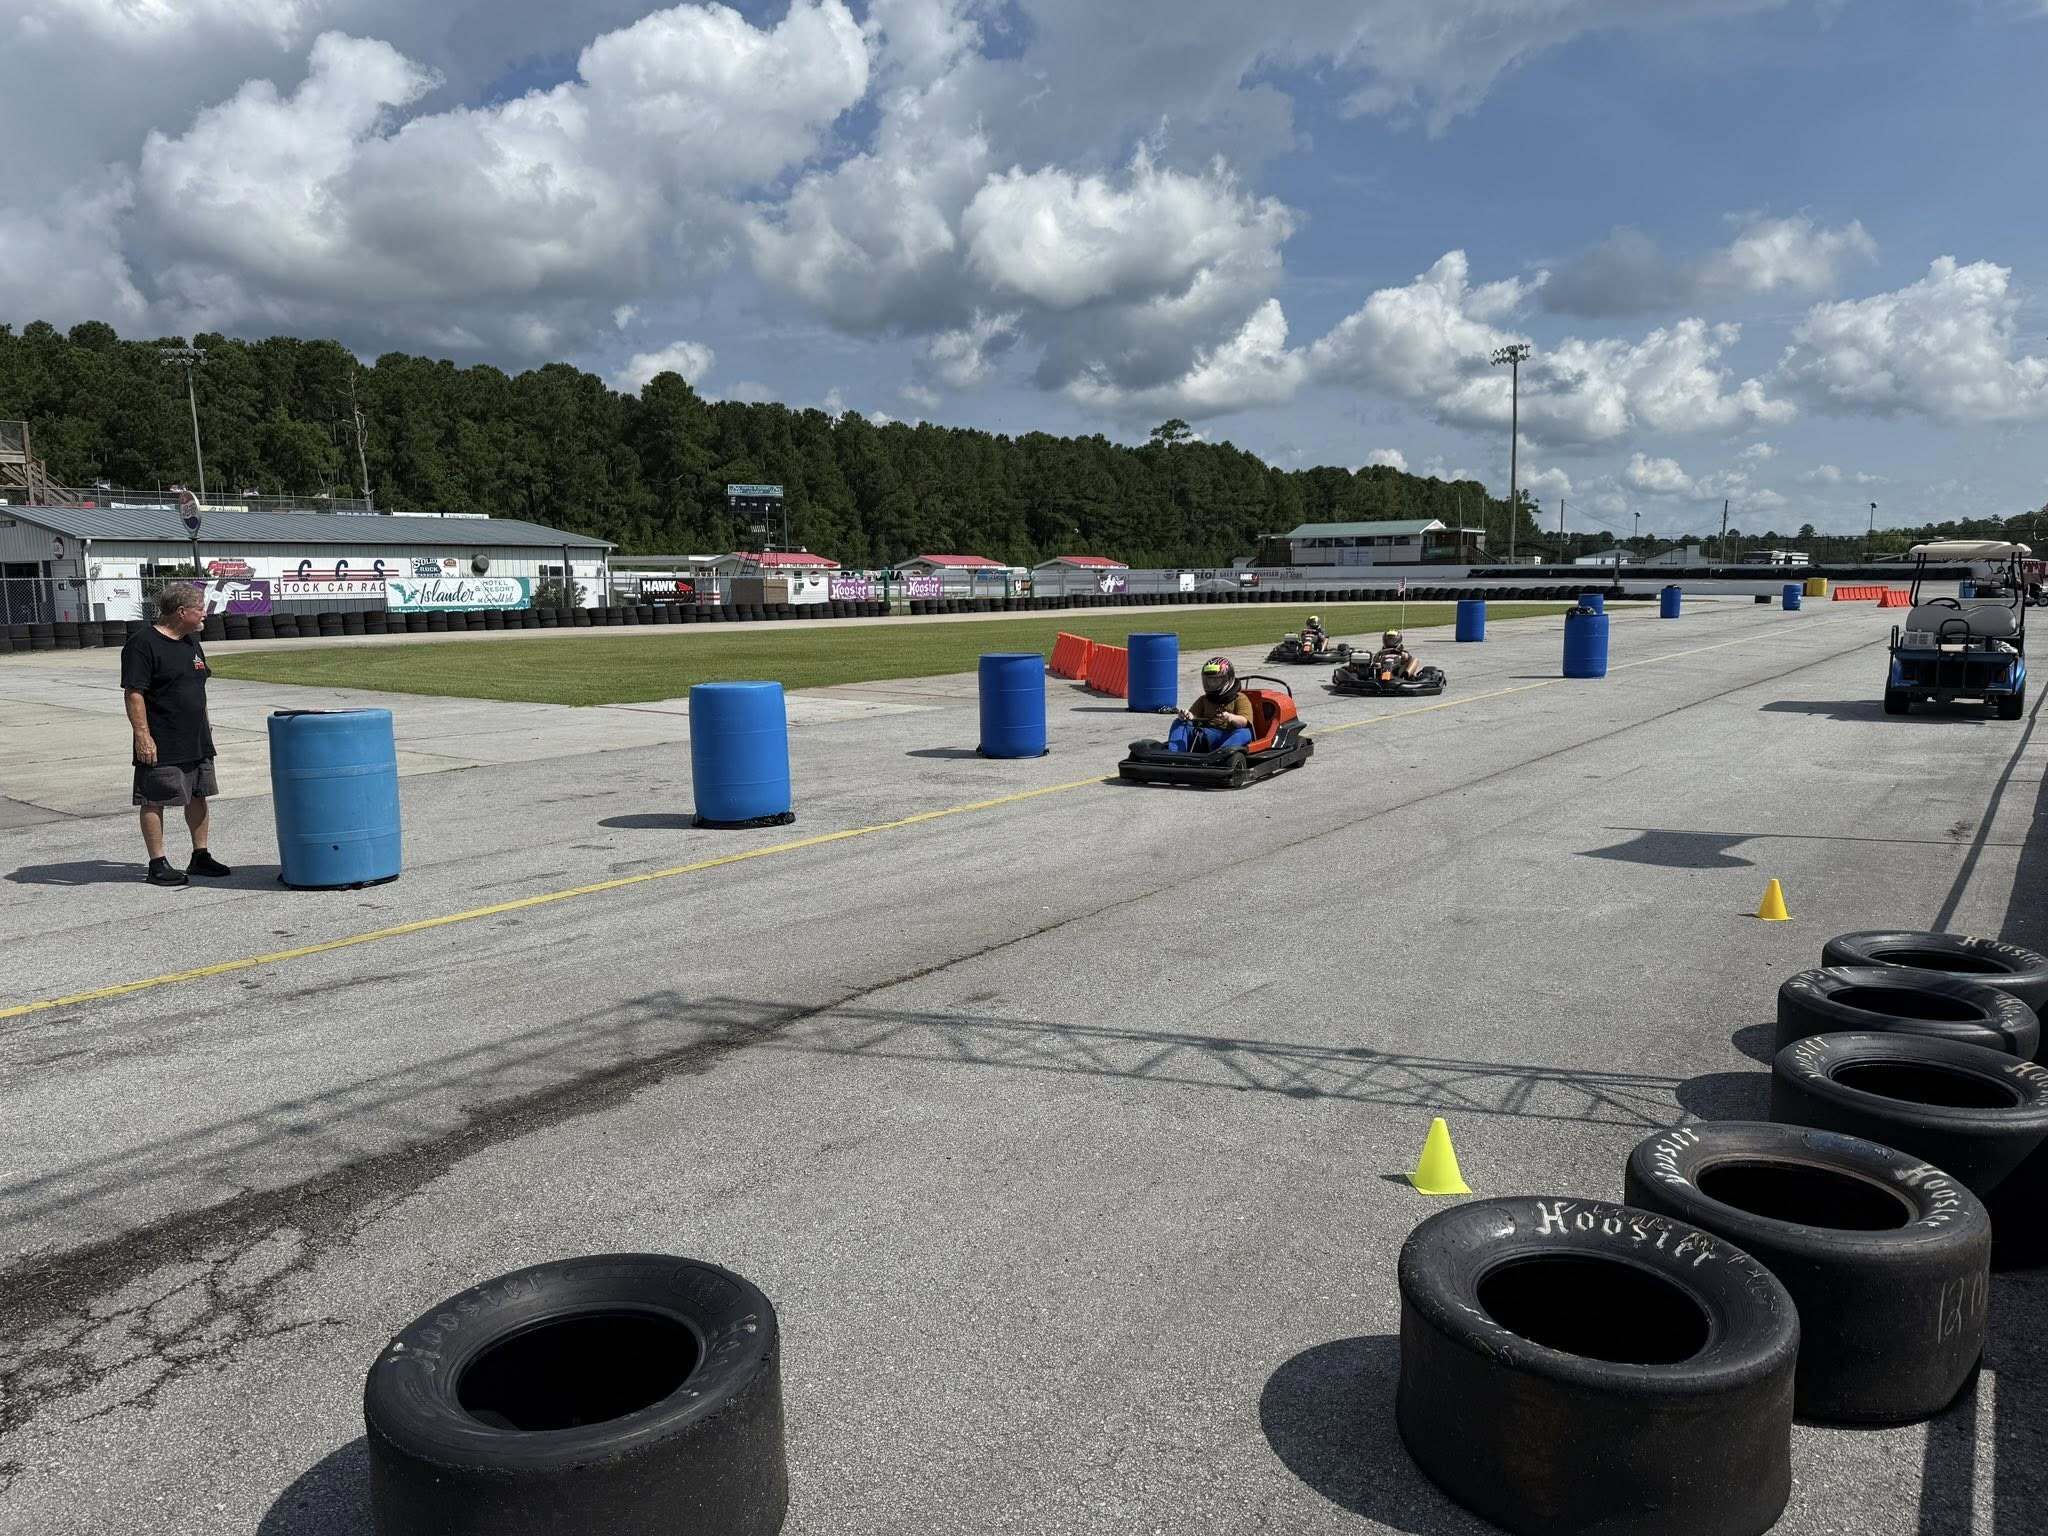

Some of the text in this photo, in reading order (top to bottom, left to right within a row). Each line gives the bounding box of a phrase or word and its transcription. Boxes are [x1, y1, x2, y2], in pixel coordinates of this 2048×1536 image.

[273, 583, 320, 594] STOCK
[327, 583, 354, 593] CAR
[420, 579, 475, 604] Islander
[642, 580, 677, 592] HAWK
[830, 582, 867, 600] Hoosier
[907, 580, 939, 596] Hoosier
[1894, 1163, 1960, 1228] Hoosier
[1536, 1201, 1717, 1267] Hoosier
